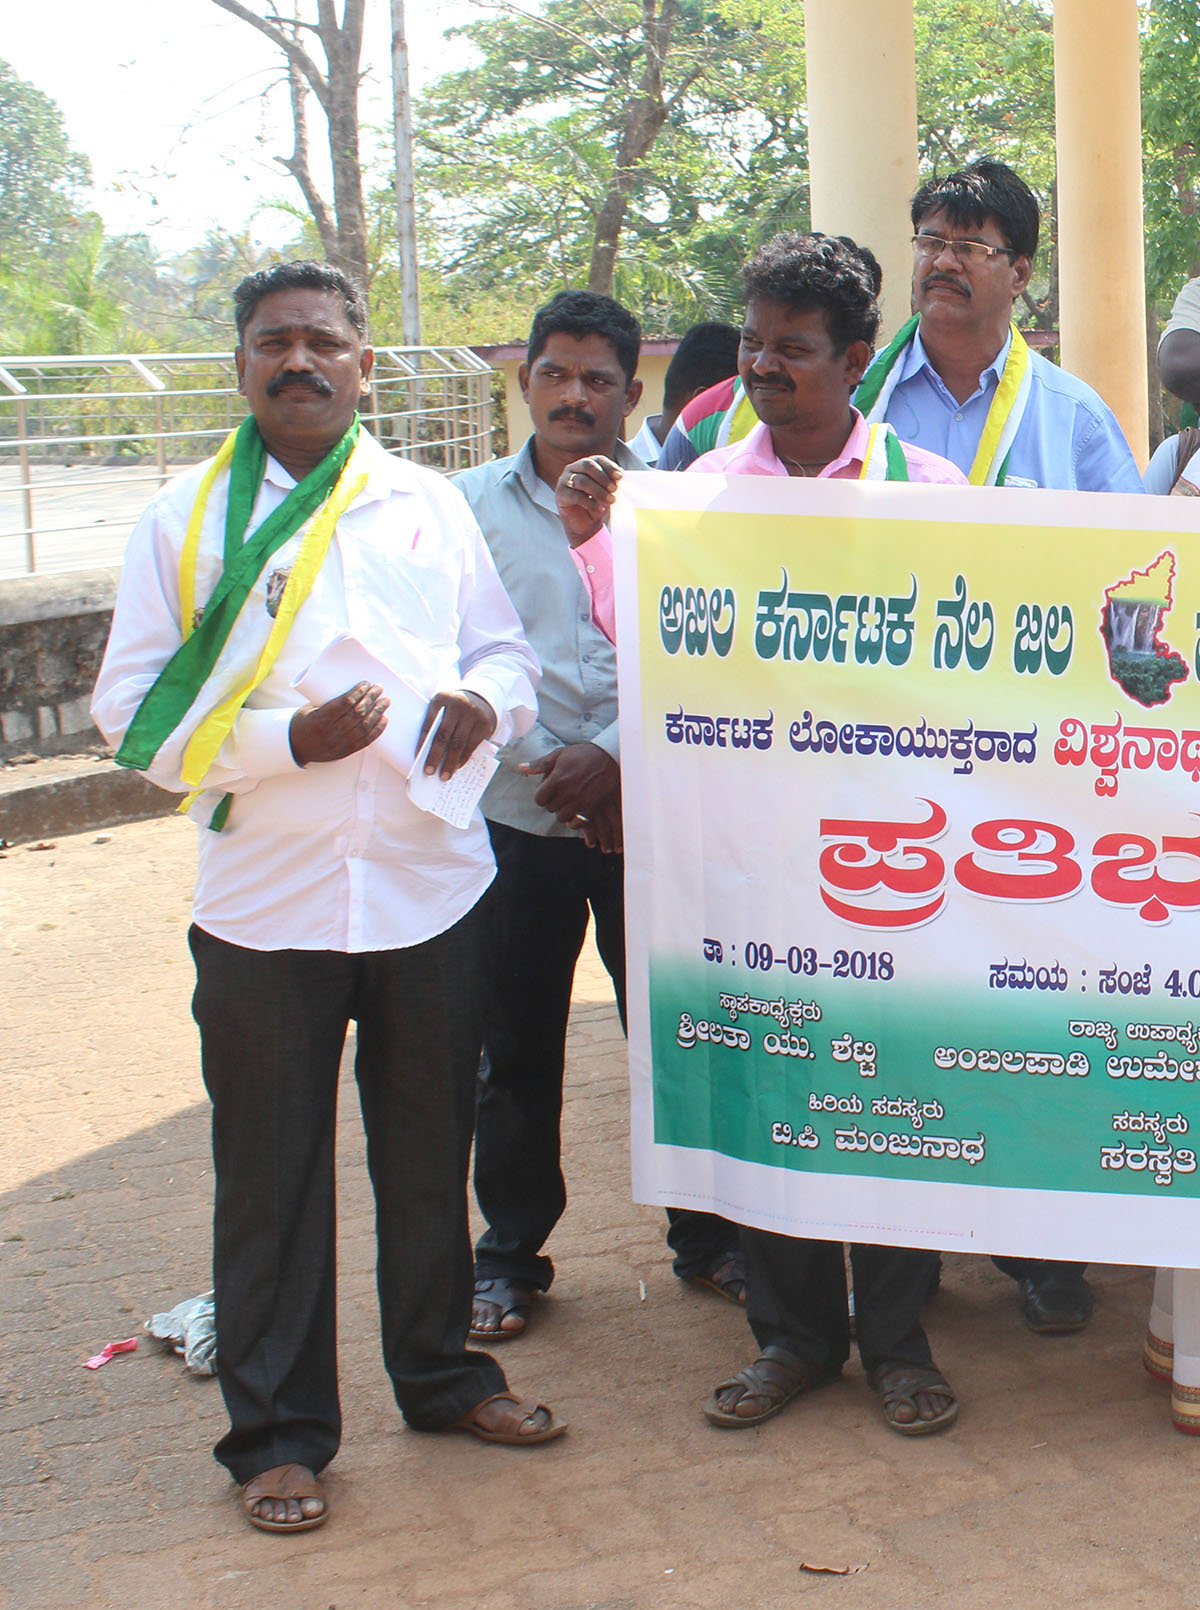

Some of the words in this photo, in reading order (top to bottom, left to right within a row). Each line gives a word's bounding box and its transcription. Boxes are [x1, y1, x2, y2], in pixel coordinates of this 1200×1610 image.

[660, 584, 735, 656] ಅಖಿಲ
[755, 567, 918, 665] ಕರ್ನಾಟಕ
[934, 574, 995, 671] ನೆಲ
[1014, 601, 1073, 676] ಜಲ
[666, 705, 773, 750] ಕರ್ನಾಟಕ
[789, 710, 1037, 775] ಲೋಕಾಯುಕ್ತರಾದ
[703, 938, 723, 964] ತಾ
[744, 941, 894, 980] 09-03-2018
[989, 956, 1068, 991] ಸಮಯ
[1099, 962, 1152, 996] ಸಂಜೆ
[719, 992, 822, 1028] ಸ್ಥಾಪಕಾಧ್ಯಕ್ಷರು
[677, 1012, 751, 1050] ಶ್ರೀಲತಾ
[763, 1029, 815, 1059] ಯು.
[831, 1033, 877, 1077] ಶೆಟ್ಟಿ
[1069, 1019, 1118, 1050] ರಾಜ್ಯ
[934, 1045, 1091, 1076] ಅಂಬಲಪಾಡಿ
[809, 1092, 863, 1114] ಹಿರಿಯ
[871, 1094, 944, 1129] ಸದಸ್ಯರು
[1112, 1110, 1189, 1143] ಸದಸ್ಯರು
[771, 1121, 820, 1149] ಟಿ.ಪಿ
[834, 1123, 986, 1166] ಮಂಜುನಾಥ
[1100, 1139, 1198, 1186] ಸರಸ್ವತಿ
